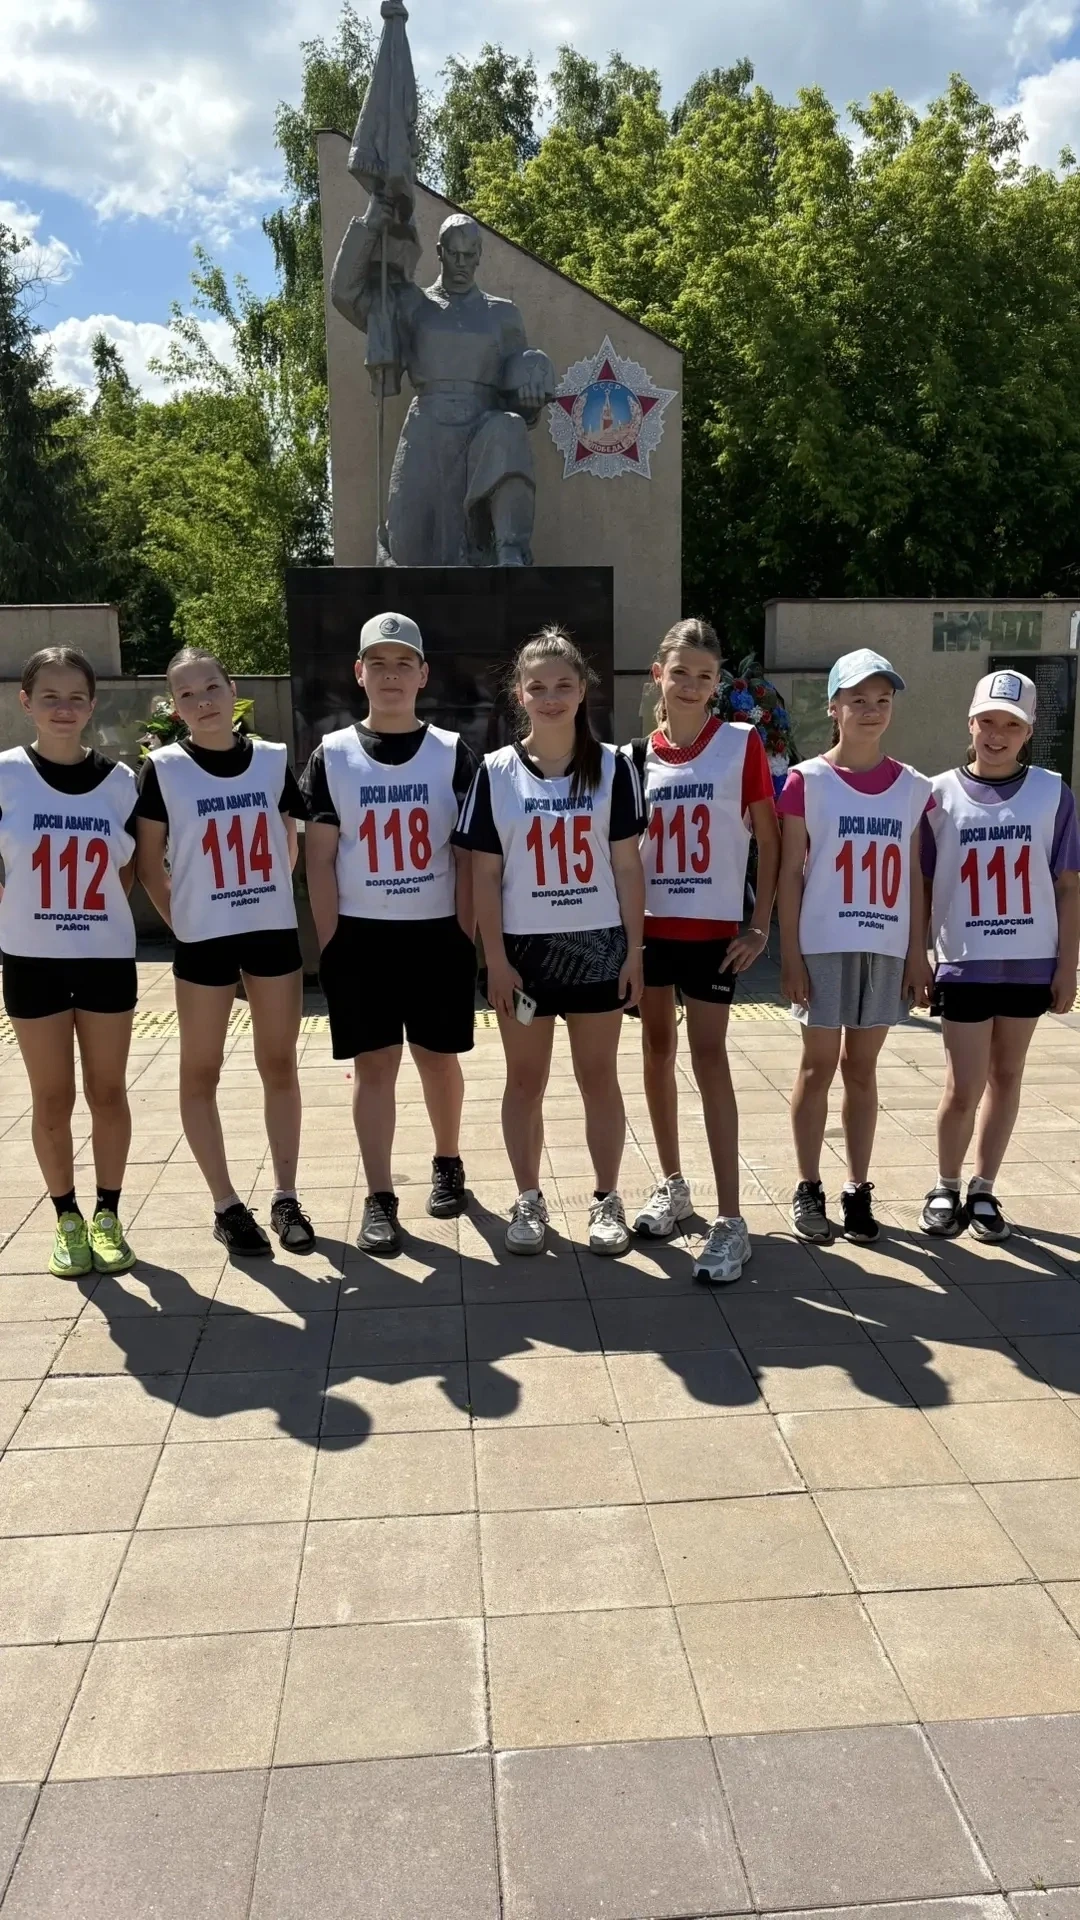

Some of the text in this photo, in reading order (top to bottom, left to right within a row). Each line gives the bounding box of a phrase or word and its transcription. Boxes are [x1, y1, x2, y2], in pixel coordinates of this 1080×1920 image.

[593, 382, 621, 391] СССР
[591, 444, 622, 453] ПОБЕДА
[360, 783, 429, 807] ДЮСШ АВАНГАРД
[673, 783, 714, 801] АВАНГАРД
[197, 791, 268, 817] ДЮСШ АВАНГАРД
[32, 813, 111, 836] ДЮСШ АВАНГАРД
[838, 816, 865, 838] ДЮСШ
[359, 807, 432, 873] 118
[648, 803, 711, 874] 113
[960, 825, 1032, 846] ДЮСШ АВАНГАРД
[202, 812, 272, 889] 114
[526, 816, 594, 886] 115
[32, 834, 109, 910] 112
[835, 840, 901, 909] 110
[365, 873, 435, 887] ВОЛОДАРСКИЙ
[650, 877, 713, 885] ВОЛОДАРСКИЙ
[961, 845, 1031, 916] 111
[211, 884, 277, 901] ВОЛОДАРСКИЙ
[386, 886, 420, 895] РАЙОН
[531, 885, 598, 898] ВОЛОДАРСКИЙ
[668, 886, 696, 894] РАЙОН
[230, 897, 260, 908] РАЙОН
[551, 898, 583, 906] РАЙОН
[34, 913, 109, 921] ВОЛОДАРСКИЙ
[838, 910, 899, 923] ВОЛОДАРСКИЙ
[965, 917, 1034, 928] ВОЛОДАРСКИЙ
[858, 920, 885, 930] РАЙОН
[983, 927, 1017, 936] РАЙОН
